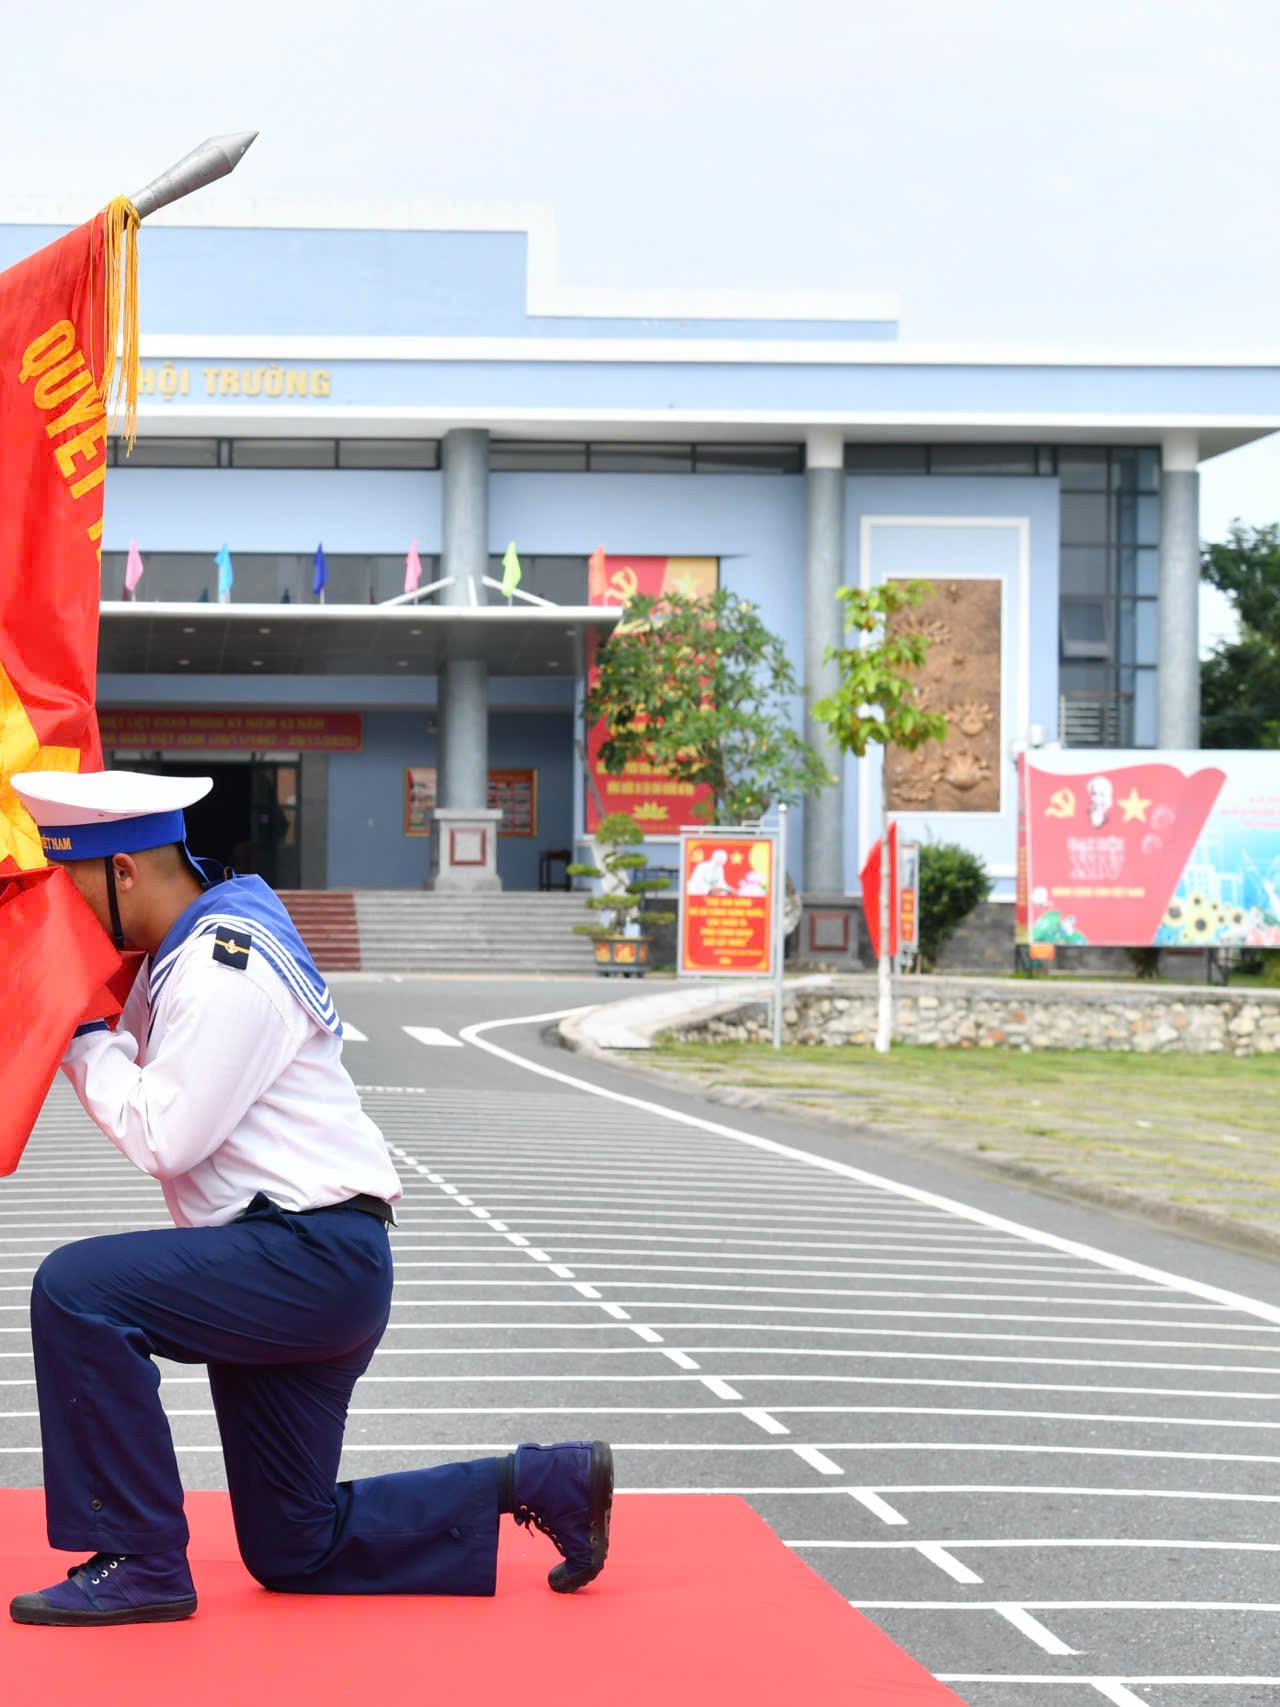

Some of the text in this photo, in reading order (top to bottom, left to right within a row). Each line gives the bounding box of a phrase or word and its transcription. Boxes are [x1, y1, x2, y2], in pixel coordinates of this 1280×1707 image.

[138, 361, 332, 403] HỘI TRƯỜNG
[50, 837, 73, 851] NAM
